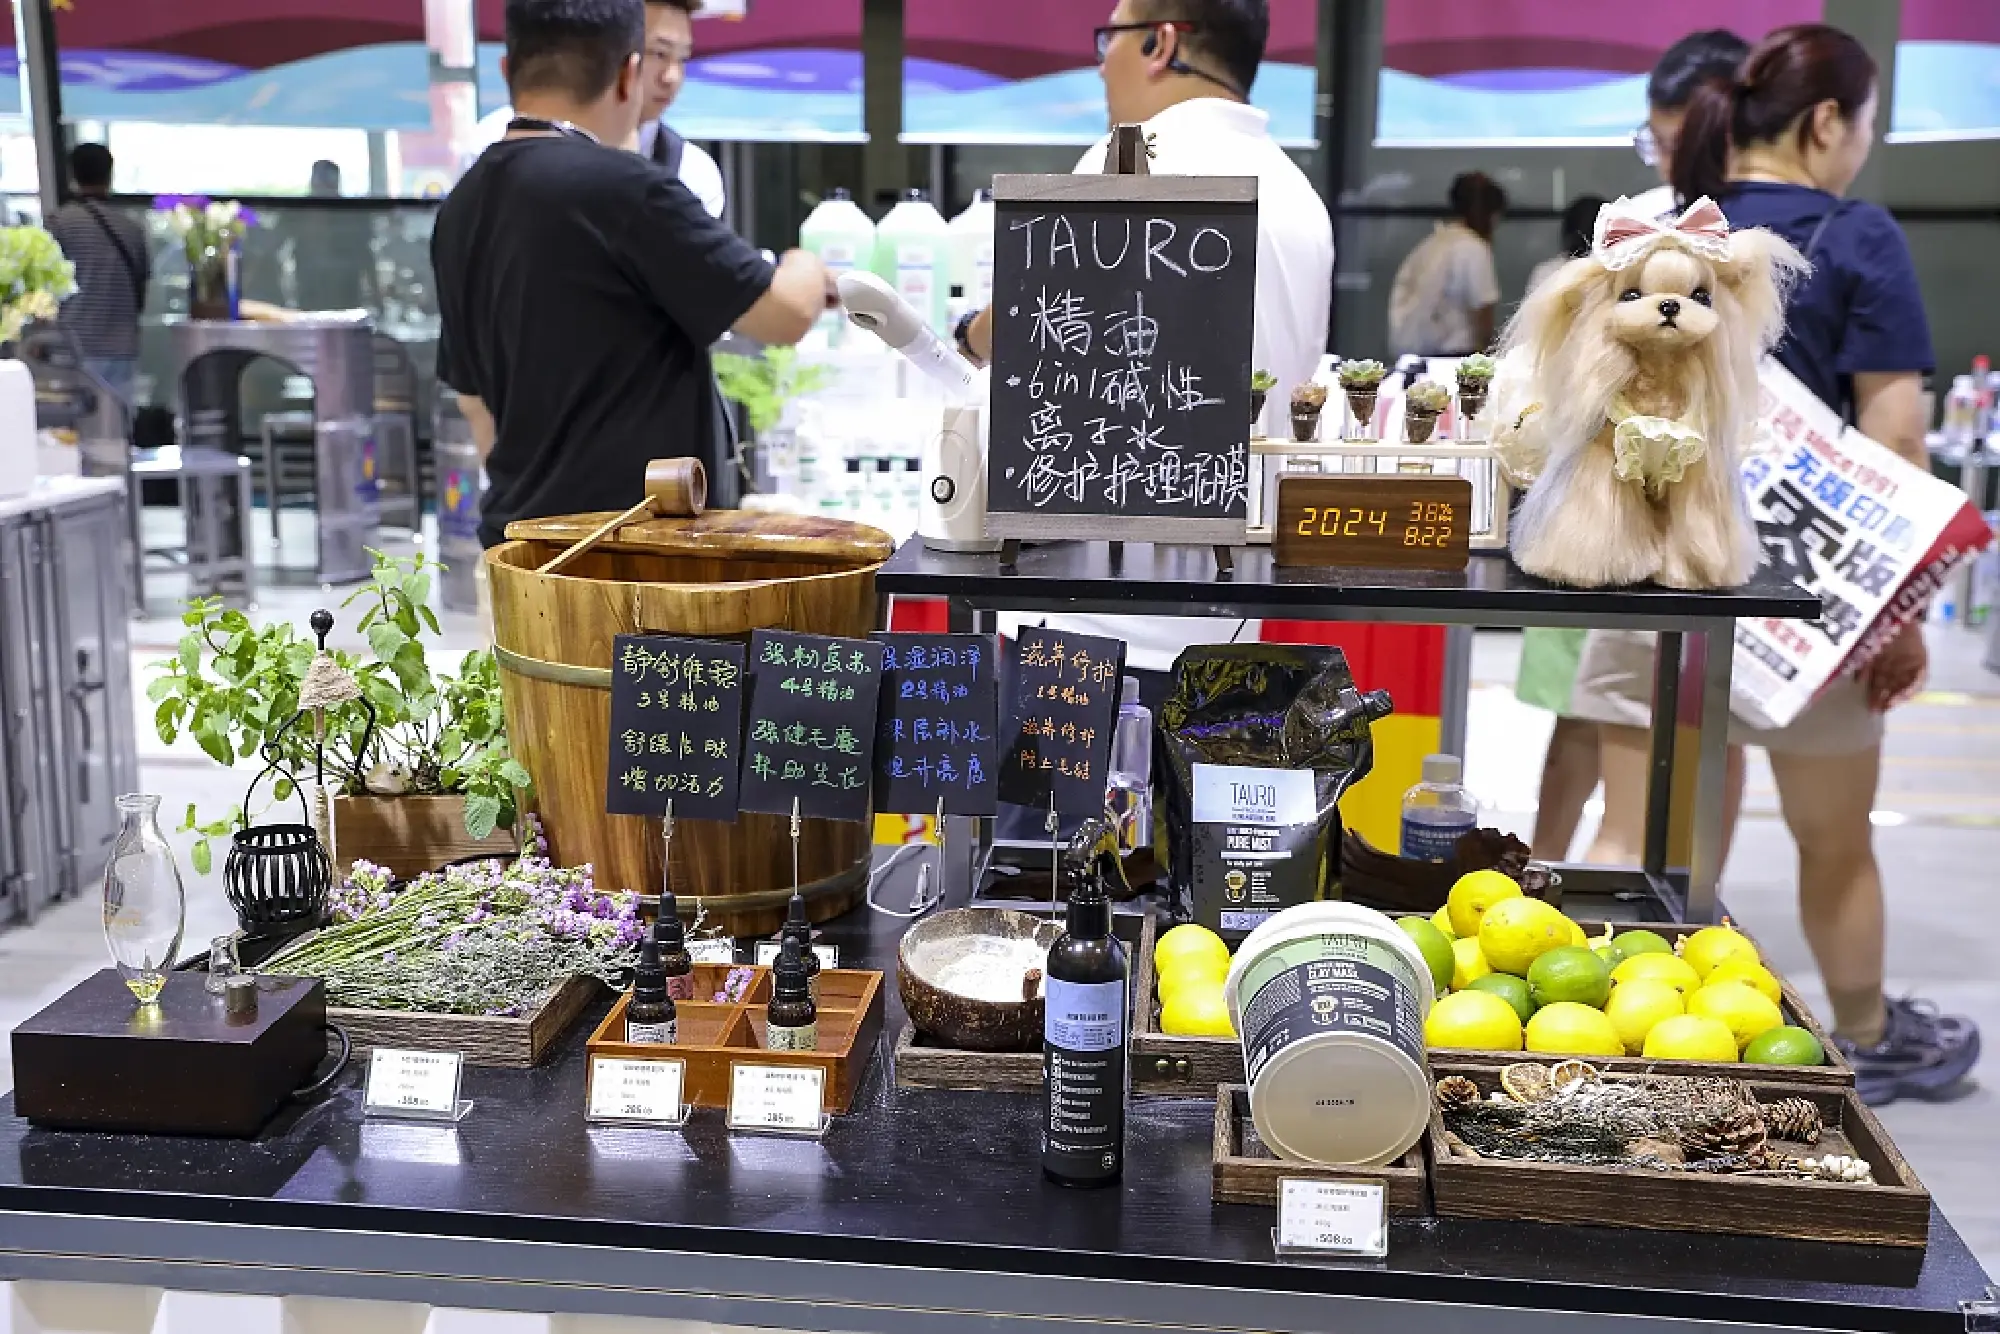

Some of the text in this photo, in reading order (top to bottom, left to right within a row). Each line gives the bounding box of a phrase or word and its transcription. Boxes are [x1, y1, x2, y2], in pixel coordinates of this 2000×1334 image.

[1010, 215, 1232, 280] TAURO
[1029, 285, 1159, 357] 精油
[1022, 400, 1184, 452] 离子水
[1297, 507, 1388, 536] 2024
[1230, 782, 1276, 808] TAURO
